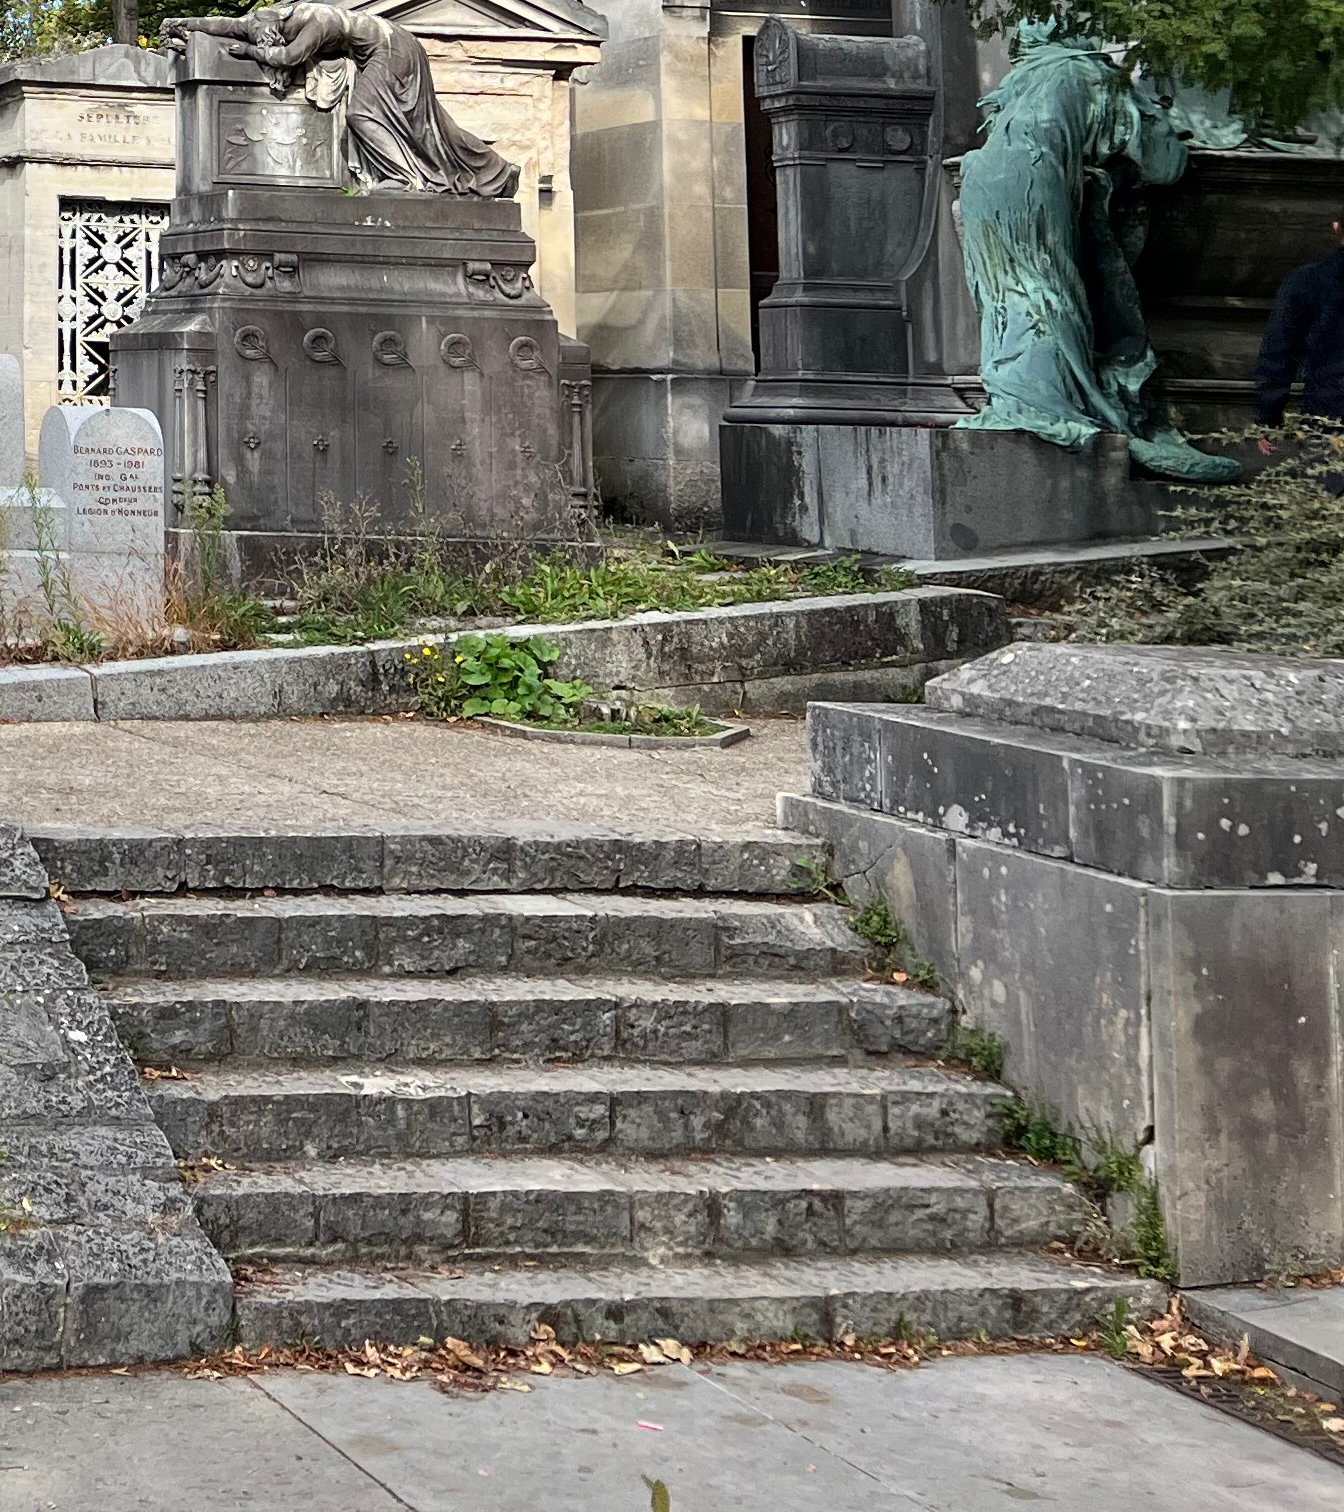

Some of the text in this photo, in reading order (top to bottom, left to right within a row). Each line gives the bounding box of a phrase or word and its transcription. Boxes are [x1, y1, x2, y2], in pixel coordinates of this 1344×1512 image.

[80, 132, 141, 146] FAMILLE
[73, 445, 163, 457] BERNARD GASPARD
[89, 459, 113, 468] 1893
[124, 460, 145, 469] 1981
[73, 483, 100, 492] PONTS
